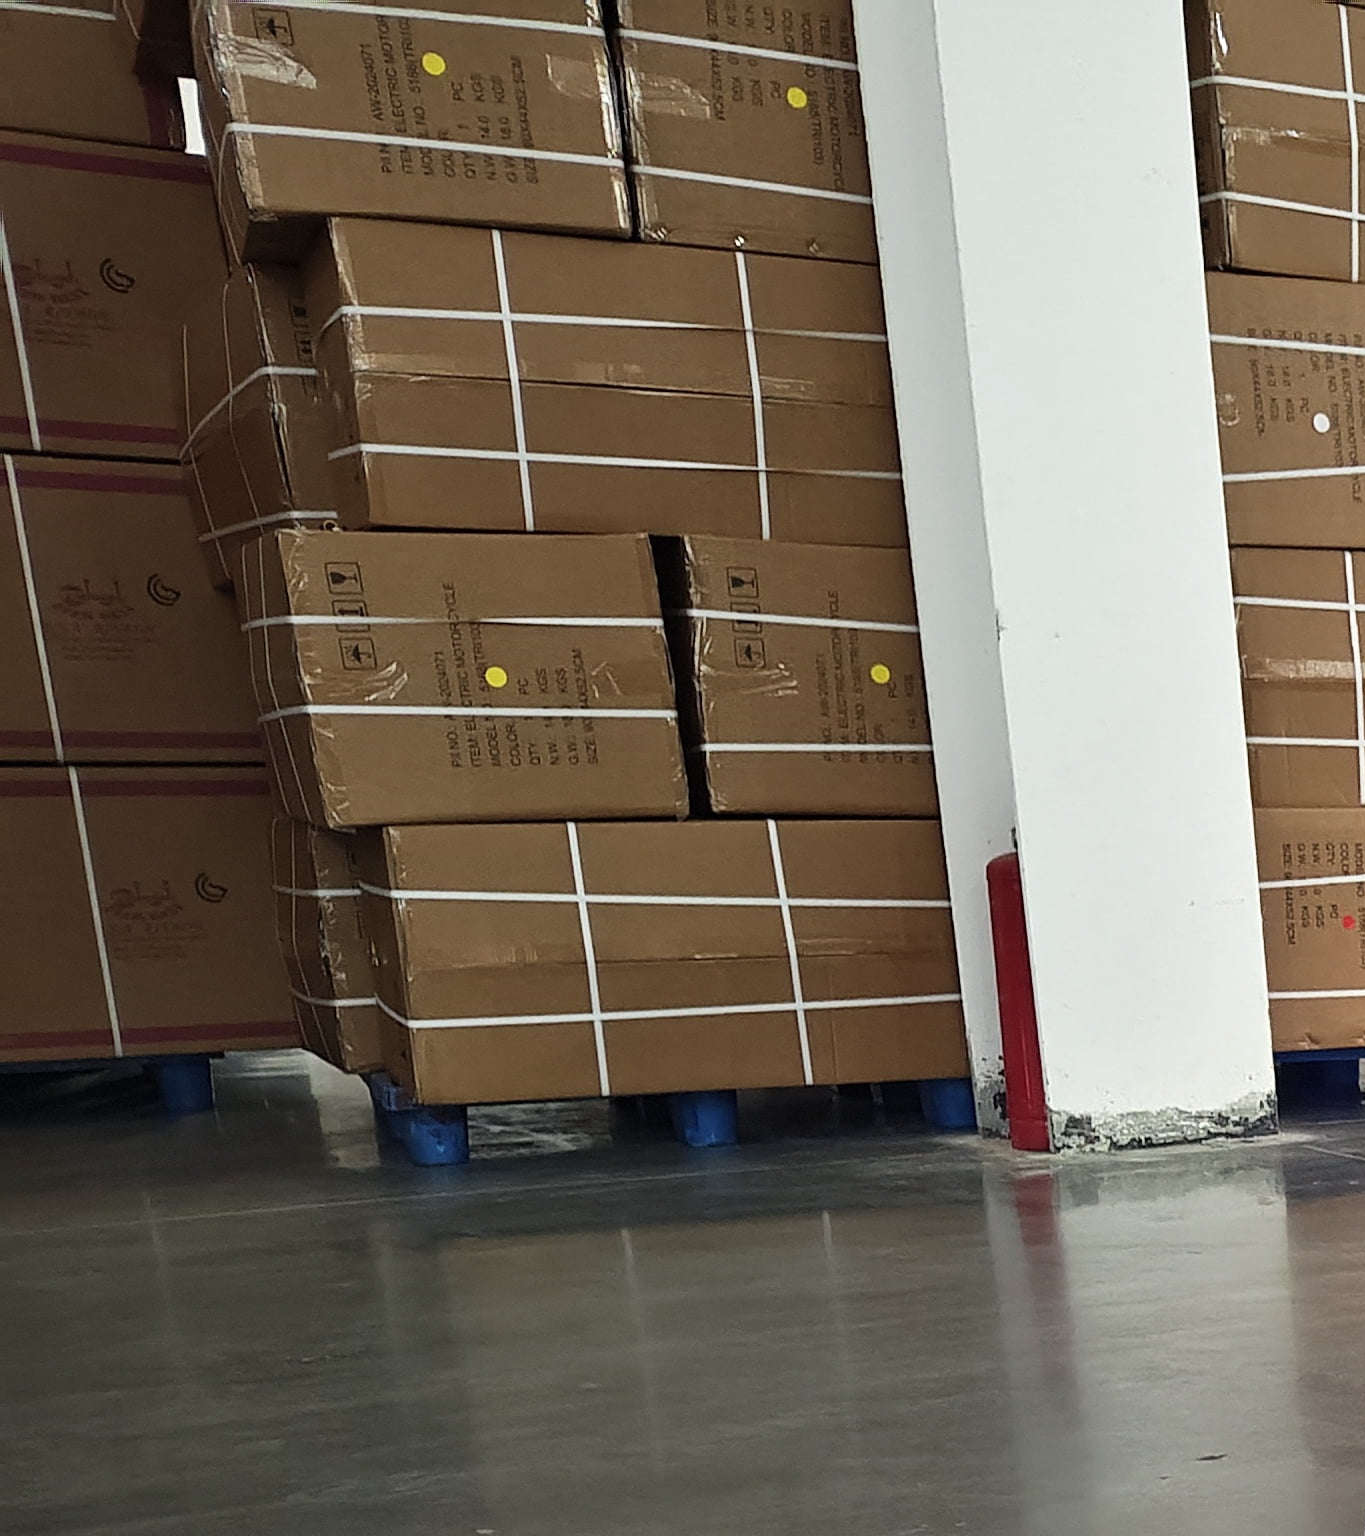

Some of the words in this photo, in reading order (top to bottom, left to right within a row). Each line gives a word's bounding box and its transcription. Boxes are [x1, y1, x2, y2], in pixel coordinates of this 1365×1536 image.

[385, 68, 407, 133] ELECTRIC
[442, 582, 465, 668] MOTORCYCLE
[517, 678, 529, 695] PC
